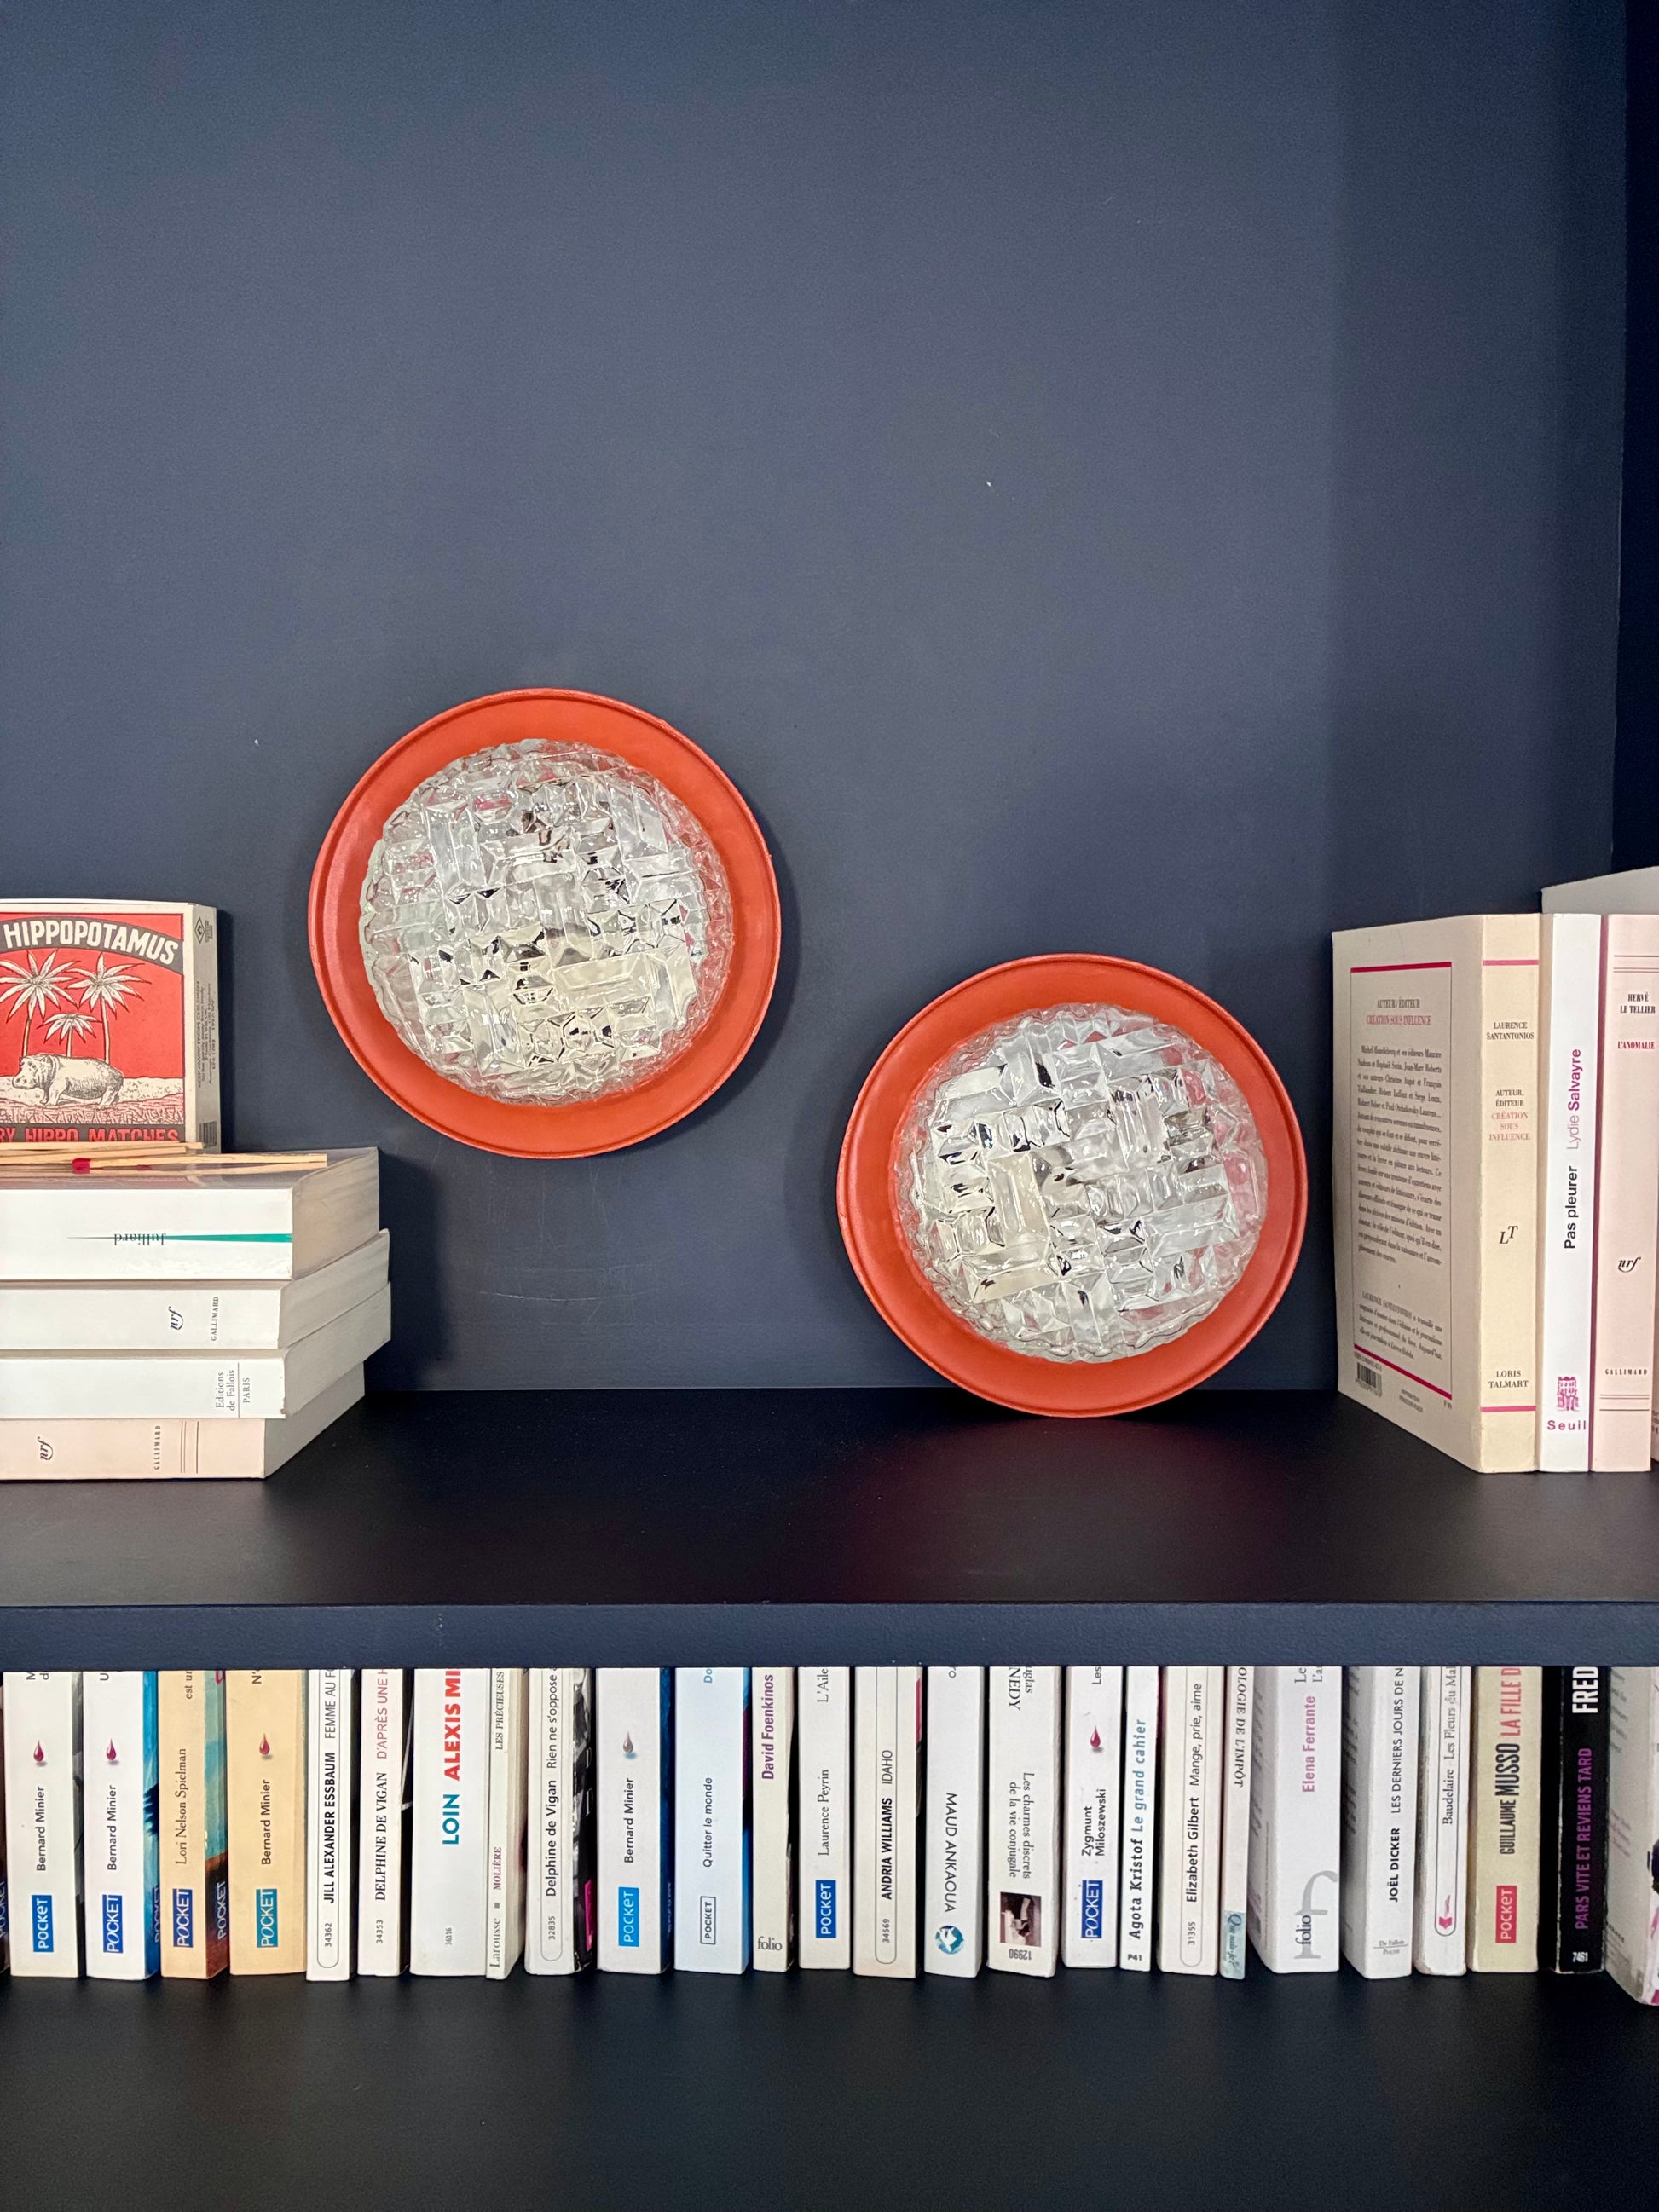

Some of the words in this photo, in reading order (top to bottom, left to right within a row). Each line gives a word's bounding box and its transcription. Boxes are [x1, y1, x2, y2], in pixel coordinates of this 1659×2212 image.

[3, 920, 178, 965] HIPPOPOTAMUS
[1377, 999, 1396, 1008] AUTEUR
[1399, 997, 1420, 1008] ÉDITEUR
[1620, 1005, 1627, 1014] LE
[1629, 1005, 1656, 1014] TELLIER
[1627, 991, 1649, 1002] HERVÉ
[1486, 1032, 1535, 1041] SANTANTONIOS
[1617, 1041, 1656, 1050] L'ANOMALIE
[1495, 1089, 1524, 1098] AUTEUR,
[1568, 1048, 1583, 1112] Salvayre
[1491, 1111, 1529, 1120] CRÉATION
[1495, 1098, 1524, 1108] ÉDITEUR
[25, 1128, 79, 1142] HIPPO
[88, 1128, 178, 1142] MATCHES
[1500, 1123, 1518, 1131] SOUS
[1566, 1116, 1582, 1150] Lydie
[1564, 1166, 1579, 1218] pleurer
[113, 1233, 166, 1246] Julliard
[1564, 1222, 1576, 1250] Pas
[211, 1296, 219, 1342] GALLIMARD
[215, 1372, 224, 1409] Editions
[226, 1369, 235, 1396] Fallois
[1488, 1380, 1529, 1389] TALMART
[1496, 1370, 1522, 1379] LORIS
[226, 1397, 235, 1411] de
[1546, 1420, 1587, 1431] Seuil
[184, 1684, 193, 1699] est
[325, 1681, 336, 1696] AU
[377, 1678, 388, 1704] UNE
[817, 1668, 829, 1703] L'Aile
[1091, 1667, 1101, 1684] Les
[1394, 1680, 1403, 1695] DE
[1572, 1667, 1598, 1713] FRED
[494, 1672, 505, 1730] PRÉCIEUSES
[547, 1674, 560, 1723] s'oppose
[761, 1674, 774, 1740] Foenkinos
[1191, 1684, 1202, 1711] aime
[1501, 1681, 1521, 1714] FILLE
[325, 1701, 336, 1739] FEMME
[374, 1707, 388, 1759] D'APRÈS
[549, 1726, 558, 1741] ne
[1191, 1715, 1204, 1740] prie,
[1235, 1715, 1246, 1736] DE
[1304, 1695, 1316, 1752] Ferrante
[1393, 1698, 1403, 1736] JOURS
[1444, 1707, 1456, 1739] Fleurs
[1501, 1718, 1520, 1736] LA
[444, 1703, 460, 1781] ALEXIS
[495, 1732, 504, 1750] LES
[547, 1744, 558, 1769] Rien
[1134, 1719, 1146, 1764] cahier
[1444, 1742, 1455, 1759] Les
[176, 1748, 188, 1799] Spielman
[761, 1743, 774, 1779] David
[882, 1750, 893, 1784] IDAHO
[1190, 1743, 1204, 1786] Mange,
[1234, 1739, 1246, 1787] L'IMPÔT
[1303, 1756, 1315, 1793] Elena
[1391, 1739, 1402, 1792] DERNIERS
[1495, 1742, 1520, 1796] MUSSO
[1578, 1748, 1593, 1781] TARD
[260, 1779, 271, 1816] Minier
[325, 1753, 335, 1807] ESSBAUM
[375, 1772, 387, 1811] VIGAN
[546, 1780, 559, 1816] Vigan
[623, 1778, 634, 1814] Minier
[703, 1777, 713, 1814] monde
[818, 1770, 831, 1803] Peyrin
[1009, 1782, 1018, 1794] de
[1021, 1772, 1033, 1790] Les
[1133, 1770, 1147, 1810] grand
[1442, 1769, 1454, 1824] Baudelaire
[34, 1786, 45, 1822] Minier
[107, 1785, 118, 1822] Minier
[176, 1801, 187, 1838] Nelson
[442, 1793, 460, 1845] LOIN
[945, 1793, 957, 1836] MAUD
[1009, 1798, 1018, 1807] la
[1009, 1811, 1018, 1826] vie
[1022, 1794, 1032, 1836] charmes
[1187, 1797, 1199, 1840] Gilbert
[1391, 1795, 1402, 1813] LES
[1577, 1785, 1592, 1842] REVIENS
[375, 1814, 386, 1833] DE
[546, 1820, 557, 1835] de
[623, 1817, 634, 1863] Bernard
[702, 1817, 713, 1827] le
[818, 1806, 830, 1856] Laurence
[882, 1798, 893, 1853] WILLIAMS
[1082, 1806, 1095, 1856] Zygmunt
[1095, 1788, 1107, 1856] Miloszewski
[1132, 1816, 1143, 1832] Le
[1500, 1799, 1517, 1855] GUILLAUME
[35, 1826, 46, 1871] Bernard
[107, 1825, 118, 1870] Bernard
[175, 1841, 187, 1864] Lori
[261, 1818, 271, 1864] Bernard
[325, 1811, 335, 1878] ALEXANDER
[702, 1830, 714, 1868] Quitter
[1009, 1828, 1020, 1878] conjugale
[1021, 1839, 1034, 1879] discrets
[1389, 1828, 1400, 1871] DICKER
[1576, 1845, 1590, 1860] ET
[375, 1836, 386, 1901] DELPHINE
[491, 1847, 502, 1890] MOLIÈRE
[546, 1839, 558, 1897] Delphine
[882, 1857, 892, 1900] ANDRIA
[944, 1840, 957, 1912] ANKAOUA
[1130, 1839, 1142, 1891] Kristof
[1187, 1845, 1199, 1903] Elizabeth
[1575, 1863, 1590, 1891] VITE
[324, 1881, 335, 1904] JILL
[1388, 1874, 1399, 1903] JOËL
[105, 1894, 119, 1953] POCKET
[174, 1889, 190, 1946] POCKET
[216, 1881, 227, 1939] POCKET
[257, 1889, 275, 1947] POCKET
[1084, 1880, 1100, 1938] POCKET
[1129, 1897, 1143, 1939] Agota
[1575, 1896, 1589, 1930] PARS
[324, 1922, 332, 1947] 34362
[375, 1920, 384, 1944] 34353
[444, 1927, 453, 1945] 36116
[489, 1918, 500, 1968] Larousse
[547, 1915, 556, 1940] 32835
[757, 1936, 783, 1950] folio
[1188, 1921, 1196, 1945] 31355
[1295, 1915, 1313, 1945] folio
[1009, 1949, 1032, 1961] 12990
